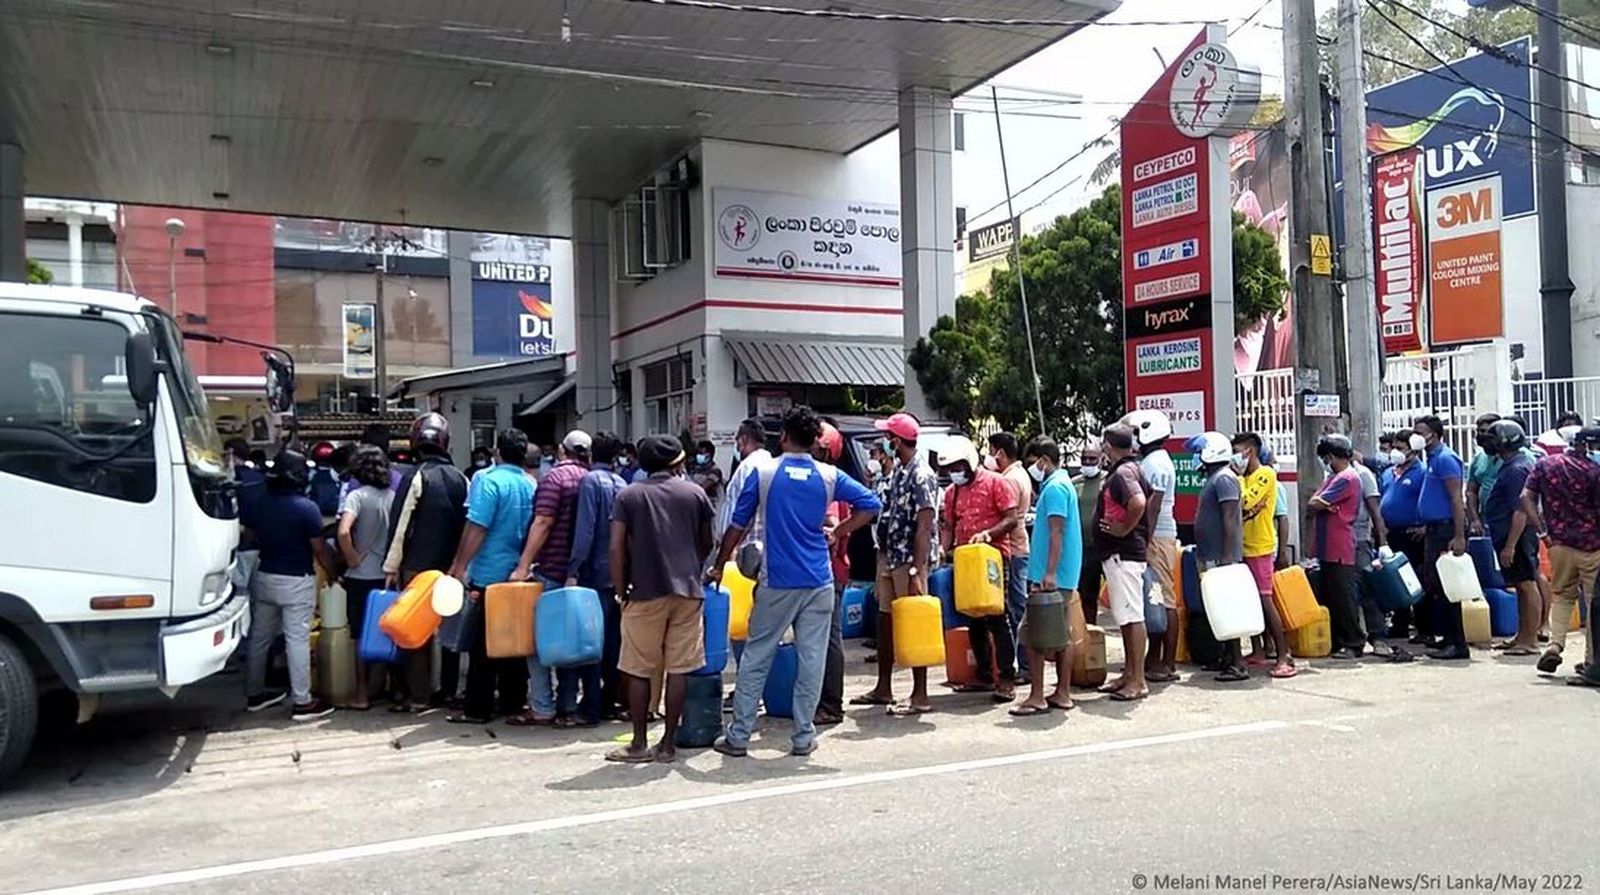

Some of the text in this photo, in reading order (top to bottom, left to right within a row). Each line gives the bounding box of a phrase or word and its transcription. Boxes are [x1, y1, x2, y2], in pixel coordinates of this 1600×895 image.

[1136, 150, 1193, 179] CEYPETCO
[1426, 136, 1483, 178] ux
[1134, 187, 1152, 202] LANKA
[1153, 181, 1174, 197] PETROL
[1135, 198, 1153, 213] LANKA
[1153, 193, 1174, 209] PETROL
[1437, 187, 1493, 229] 3M
[765, 216, 806, 233] ලංකා
[1158, 249, 1175, 262] Air
[1379, 177, 1413, 324] Multilac
[480, 261, 536, 281] UNITED
[1436, 252, 1494, 270] UNITED PAINT
[1432, 262, 1500, 281] COLOUR MIXING
[1145, 280, 1169, 297] HOURS
[1169, 275, 1198, 292] SERVICE
[1450, 276, 1482, 288] CENTRE
[1145, 306, 1190, 331] hyrax
[520, 341, 551, 355] let's
[1138, 339, 1199, 359] LANKA KEROSINE
[1138, 355, 1200, 374] LUBRICANTS
